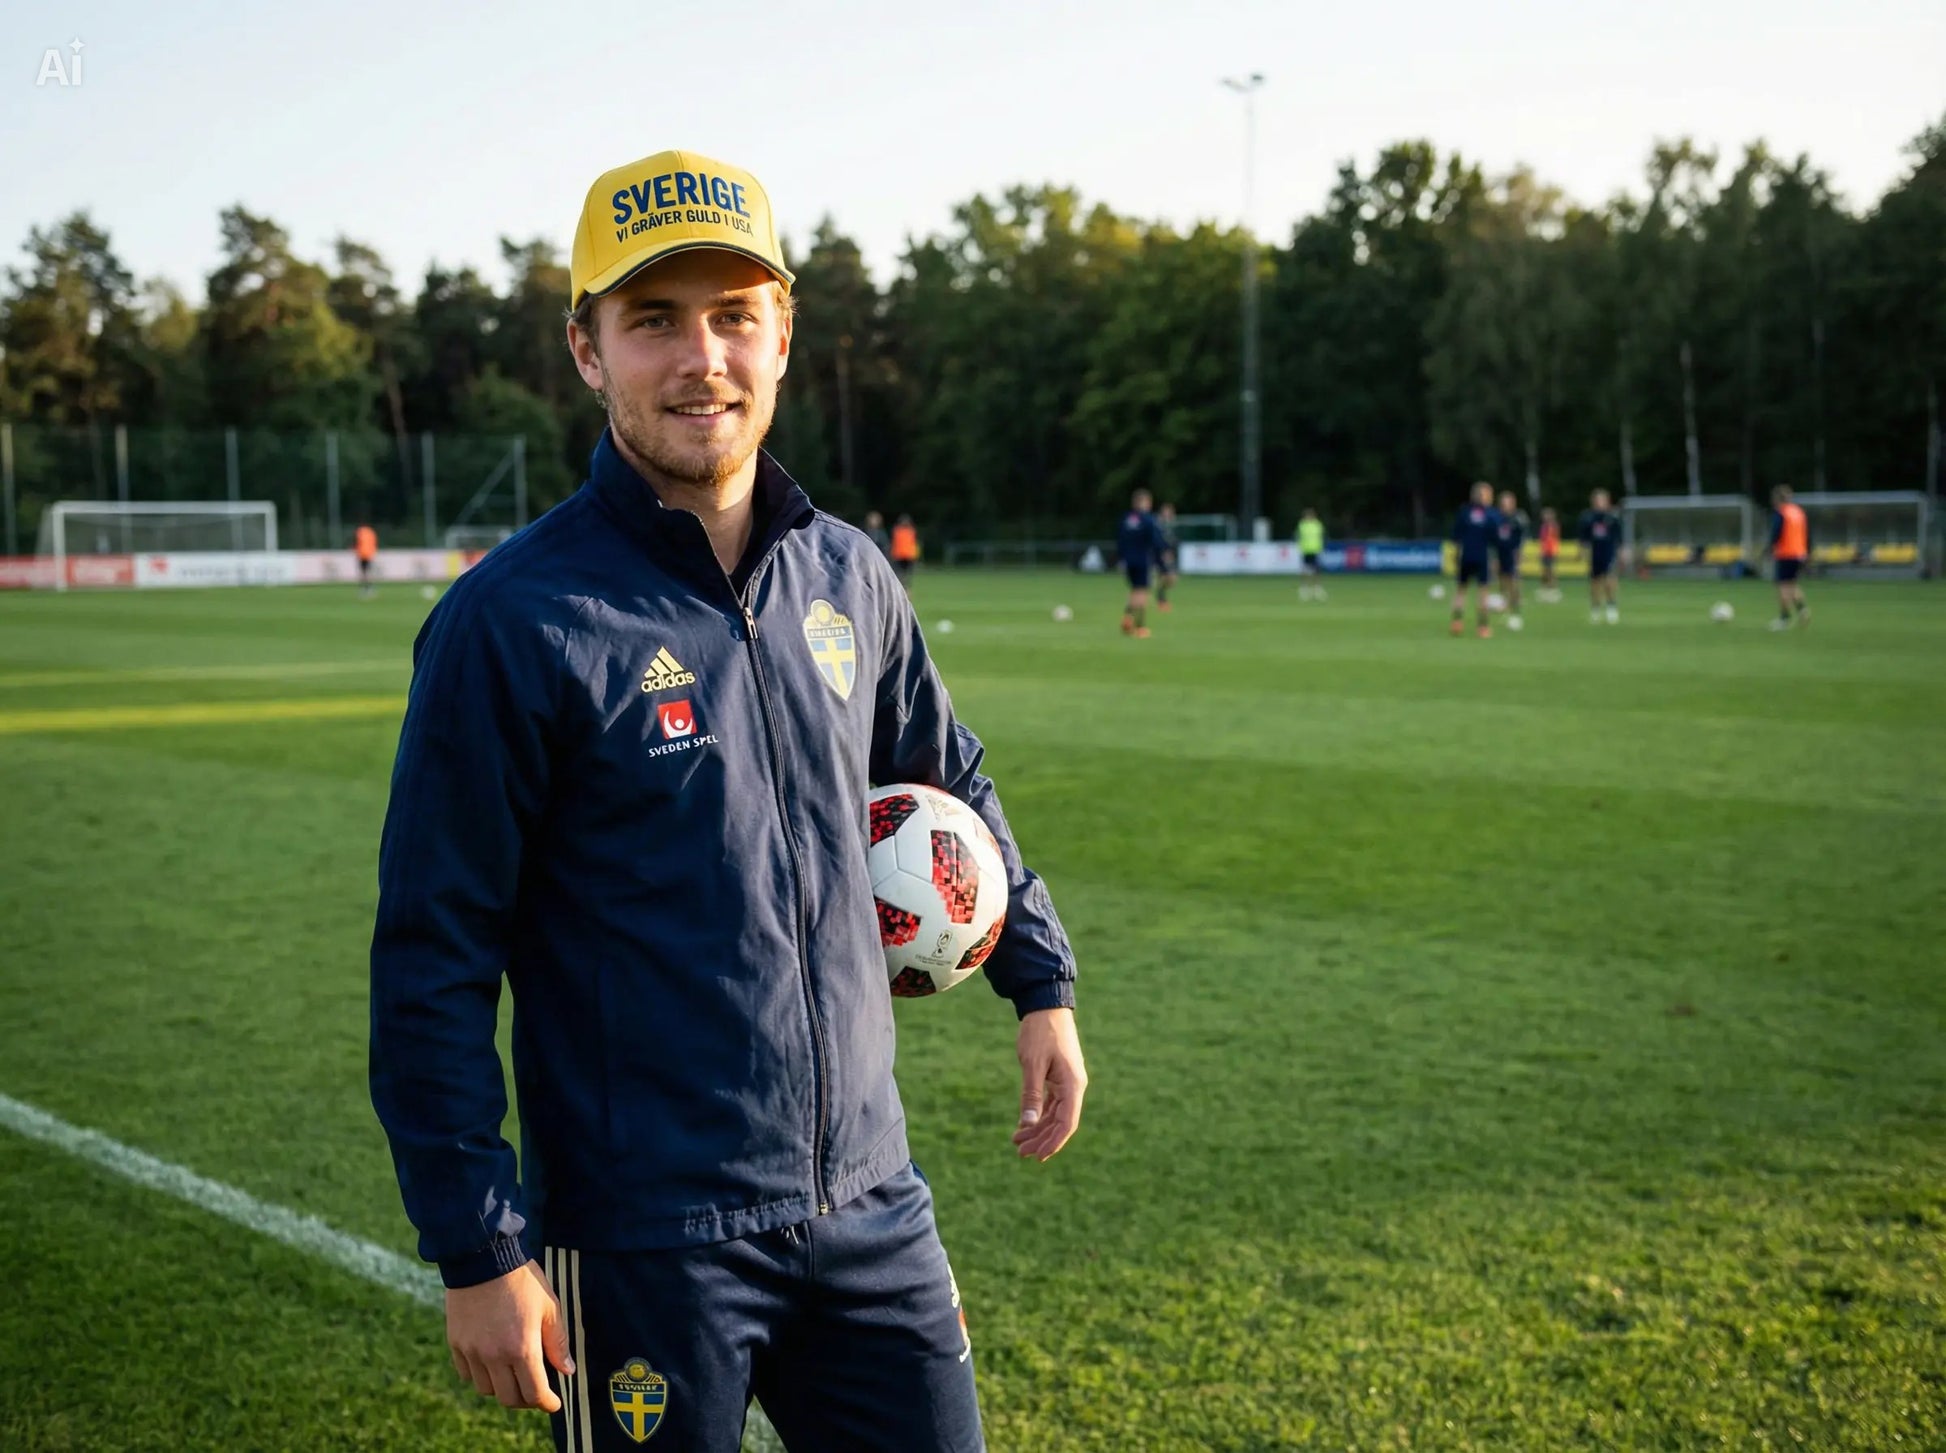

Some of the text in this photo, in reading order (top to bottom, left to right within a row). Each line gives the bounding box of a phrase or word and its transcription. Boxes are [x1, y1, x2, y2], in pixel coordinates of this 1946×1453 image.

[612, 171, 751, 225] SVERIGE
[616, 209, 754, 243] VI GRÄVER GULD I USA
[641, 671, 696, 693] adidas
[648, 740, 691, 758] SVEDEN
